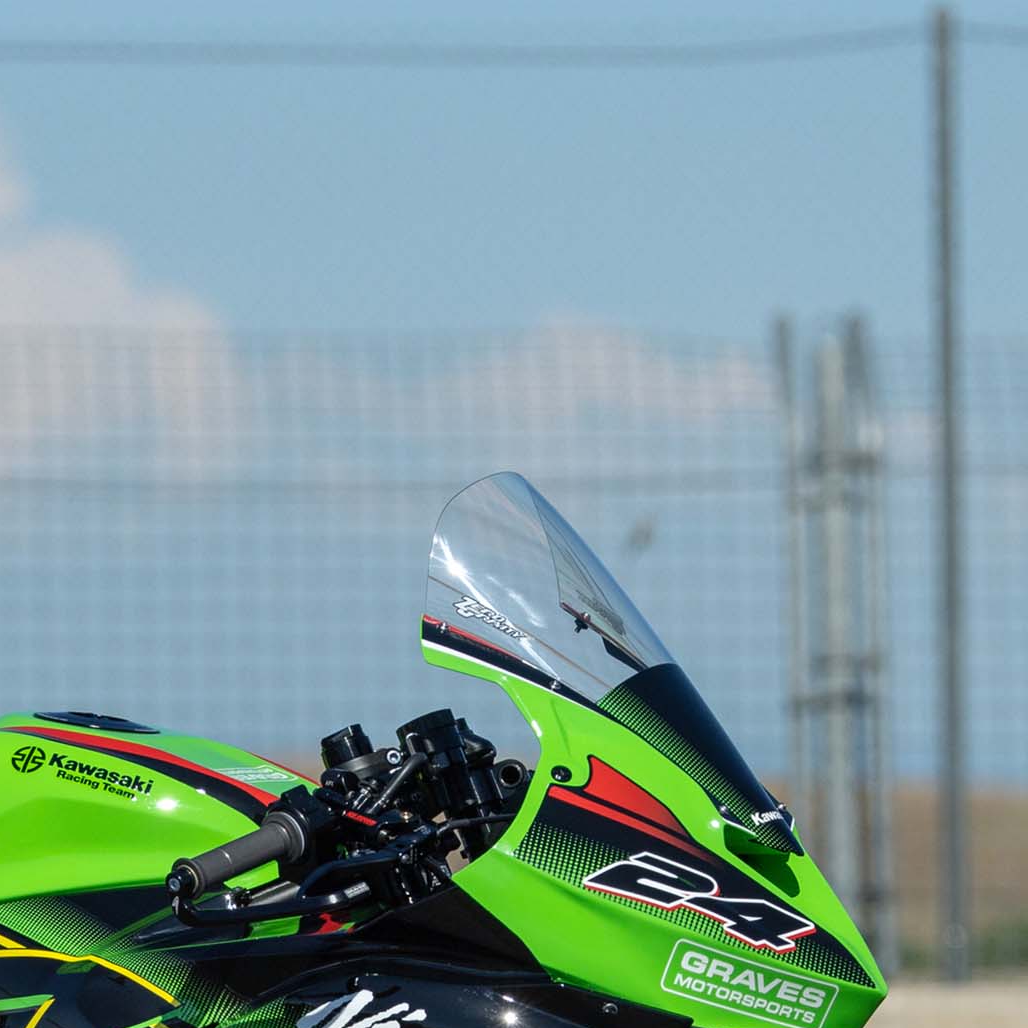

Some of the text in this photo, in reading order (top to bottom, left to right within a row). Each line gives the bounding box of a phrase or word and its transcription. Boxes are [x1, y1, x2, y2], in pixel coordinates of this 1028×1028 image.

[49, 753, 154, 795] Kawasaki
[56, 770, 136, 799] Racing Team
[584, 851, 816, 954] 24
[673, 973, 816, 1024] MOTORSPORTS
[680, 951, 826, 1009] GRAVES
